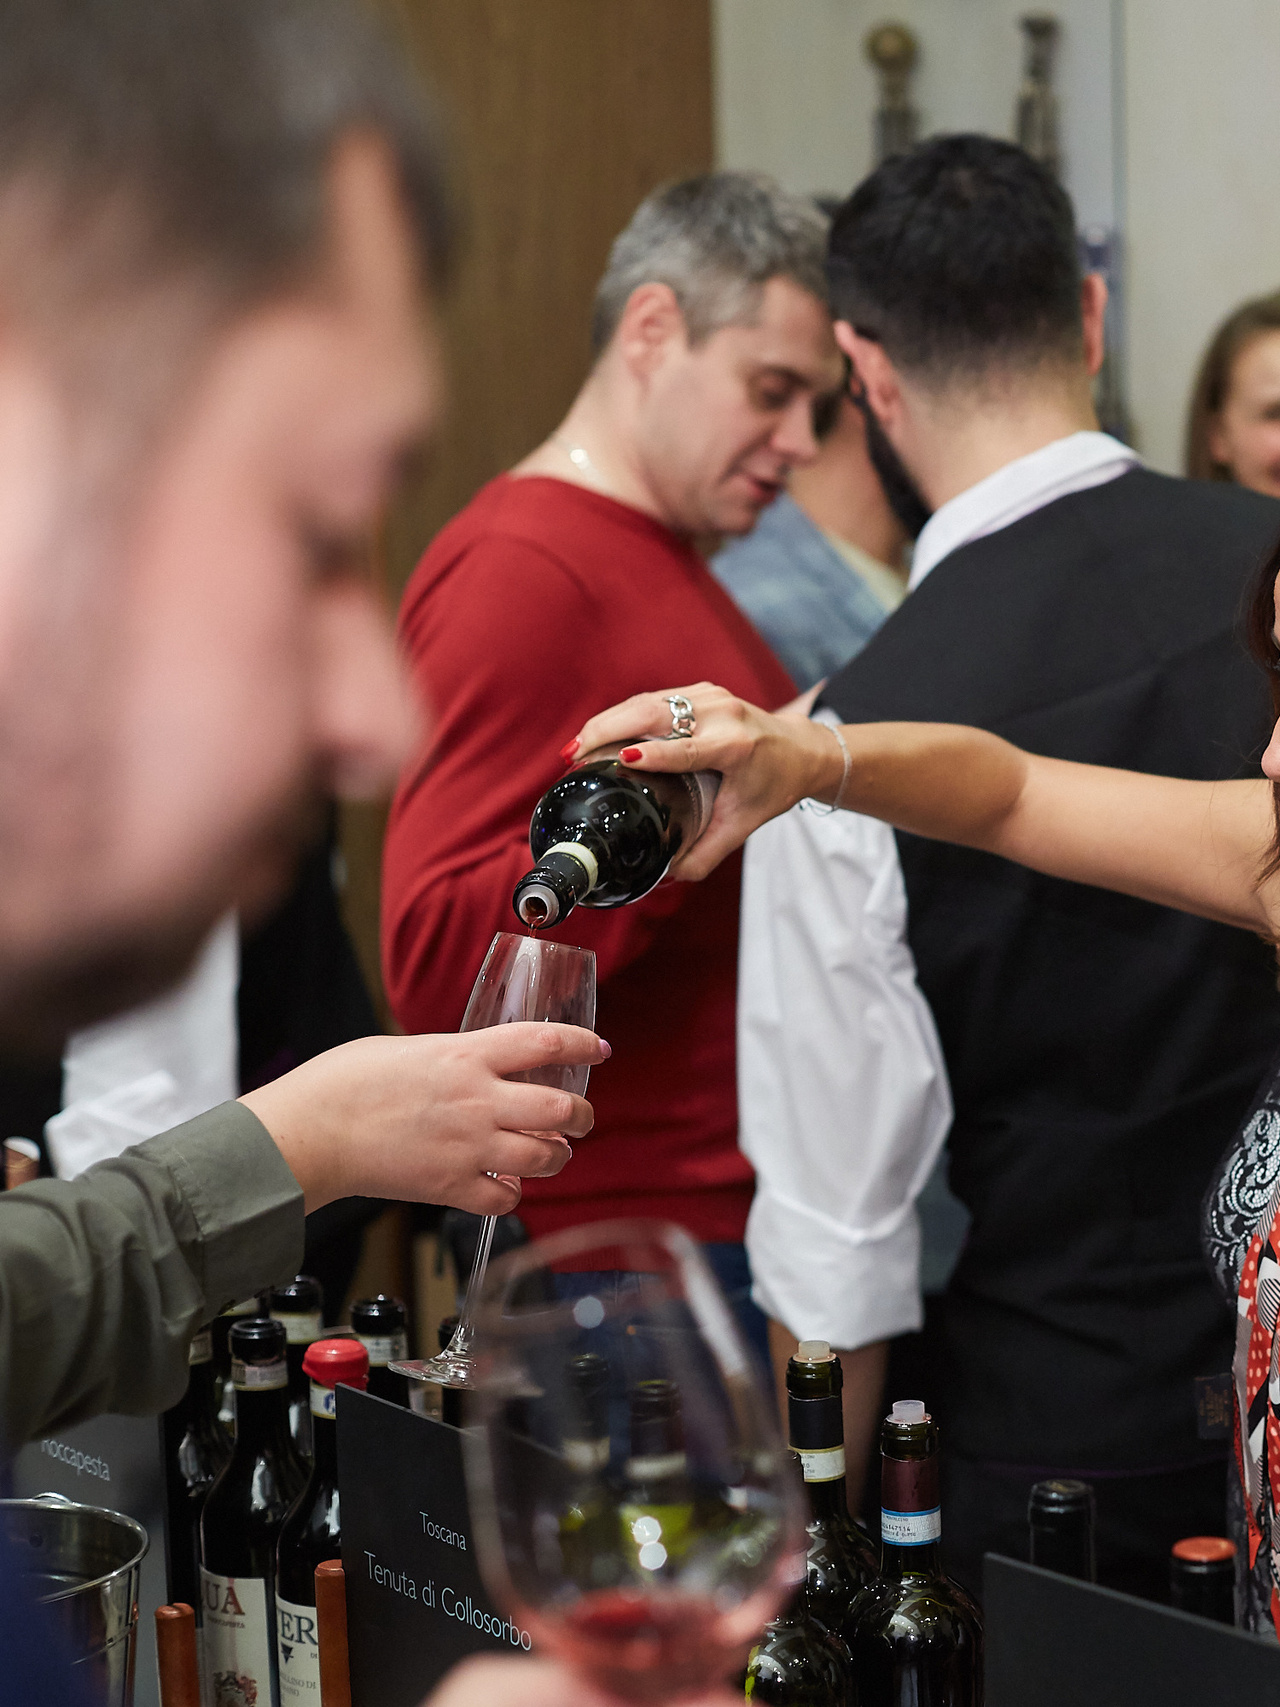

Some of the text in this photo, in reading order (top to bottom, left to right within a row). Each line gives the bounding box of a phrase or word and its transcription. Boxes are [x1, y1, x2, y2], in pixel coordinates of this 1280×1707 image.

[419, 1511, 467, 1551] Toscana
[364, 1550, 532, 1651] Tenuta di Collosorbo
